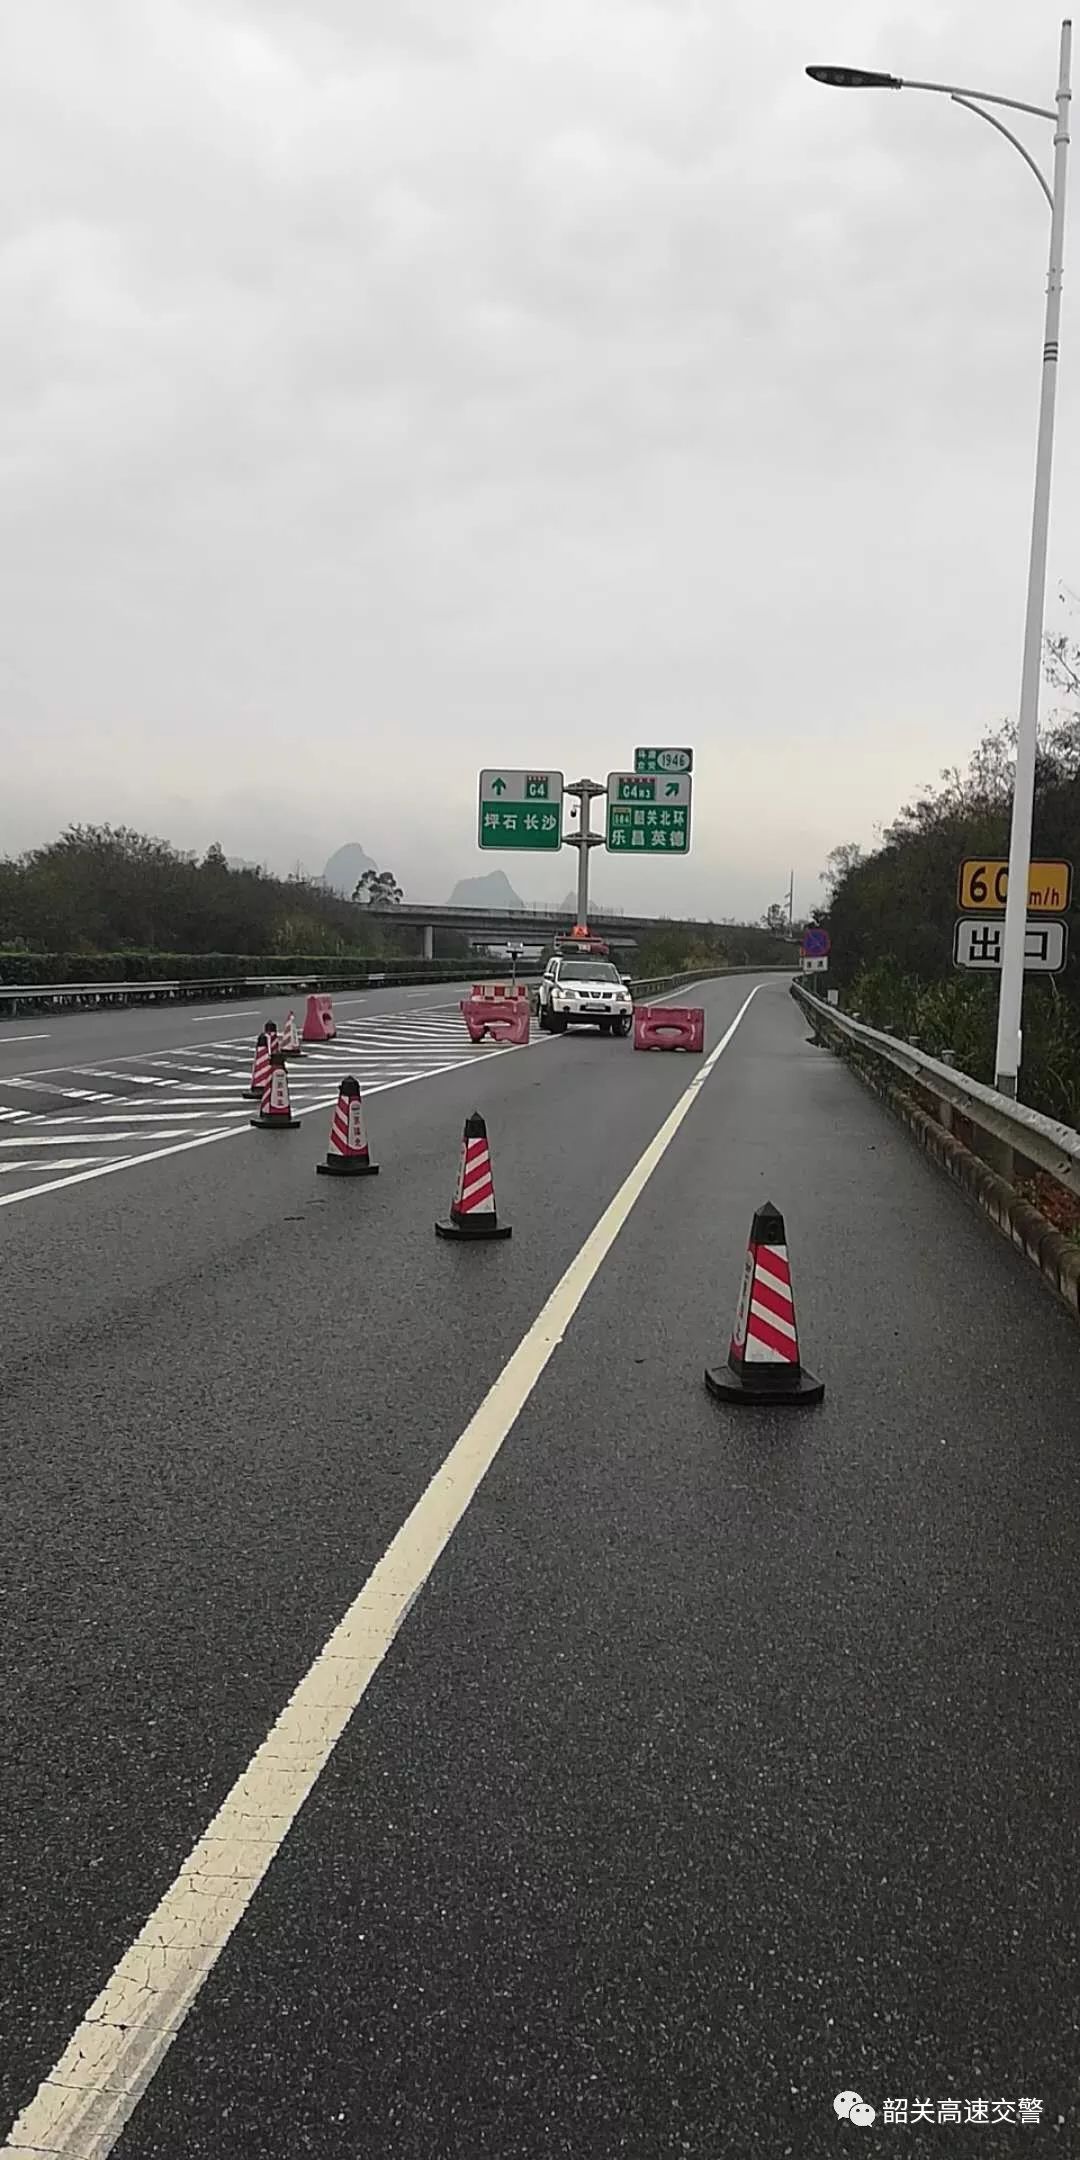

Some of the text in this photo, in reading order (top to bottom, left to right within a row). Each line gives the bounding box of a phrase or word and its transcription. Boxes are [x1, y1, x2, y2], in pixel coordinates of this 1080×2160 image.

[529, 784, 545, 797] G4
[484, 812, 557, 831] 坪石 长沙
[634, 810, 684, 826] 韶关北环
[612, 829, 685, 847] 乐昌 英德
[970, 866, 1059, 905] 60 m/h
[970, 927, 1048, 963] 出口
